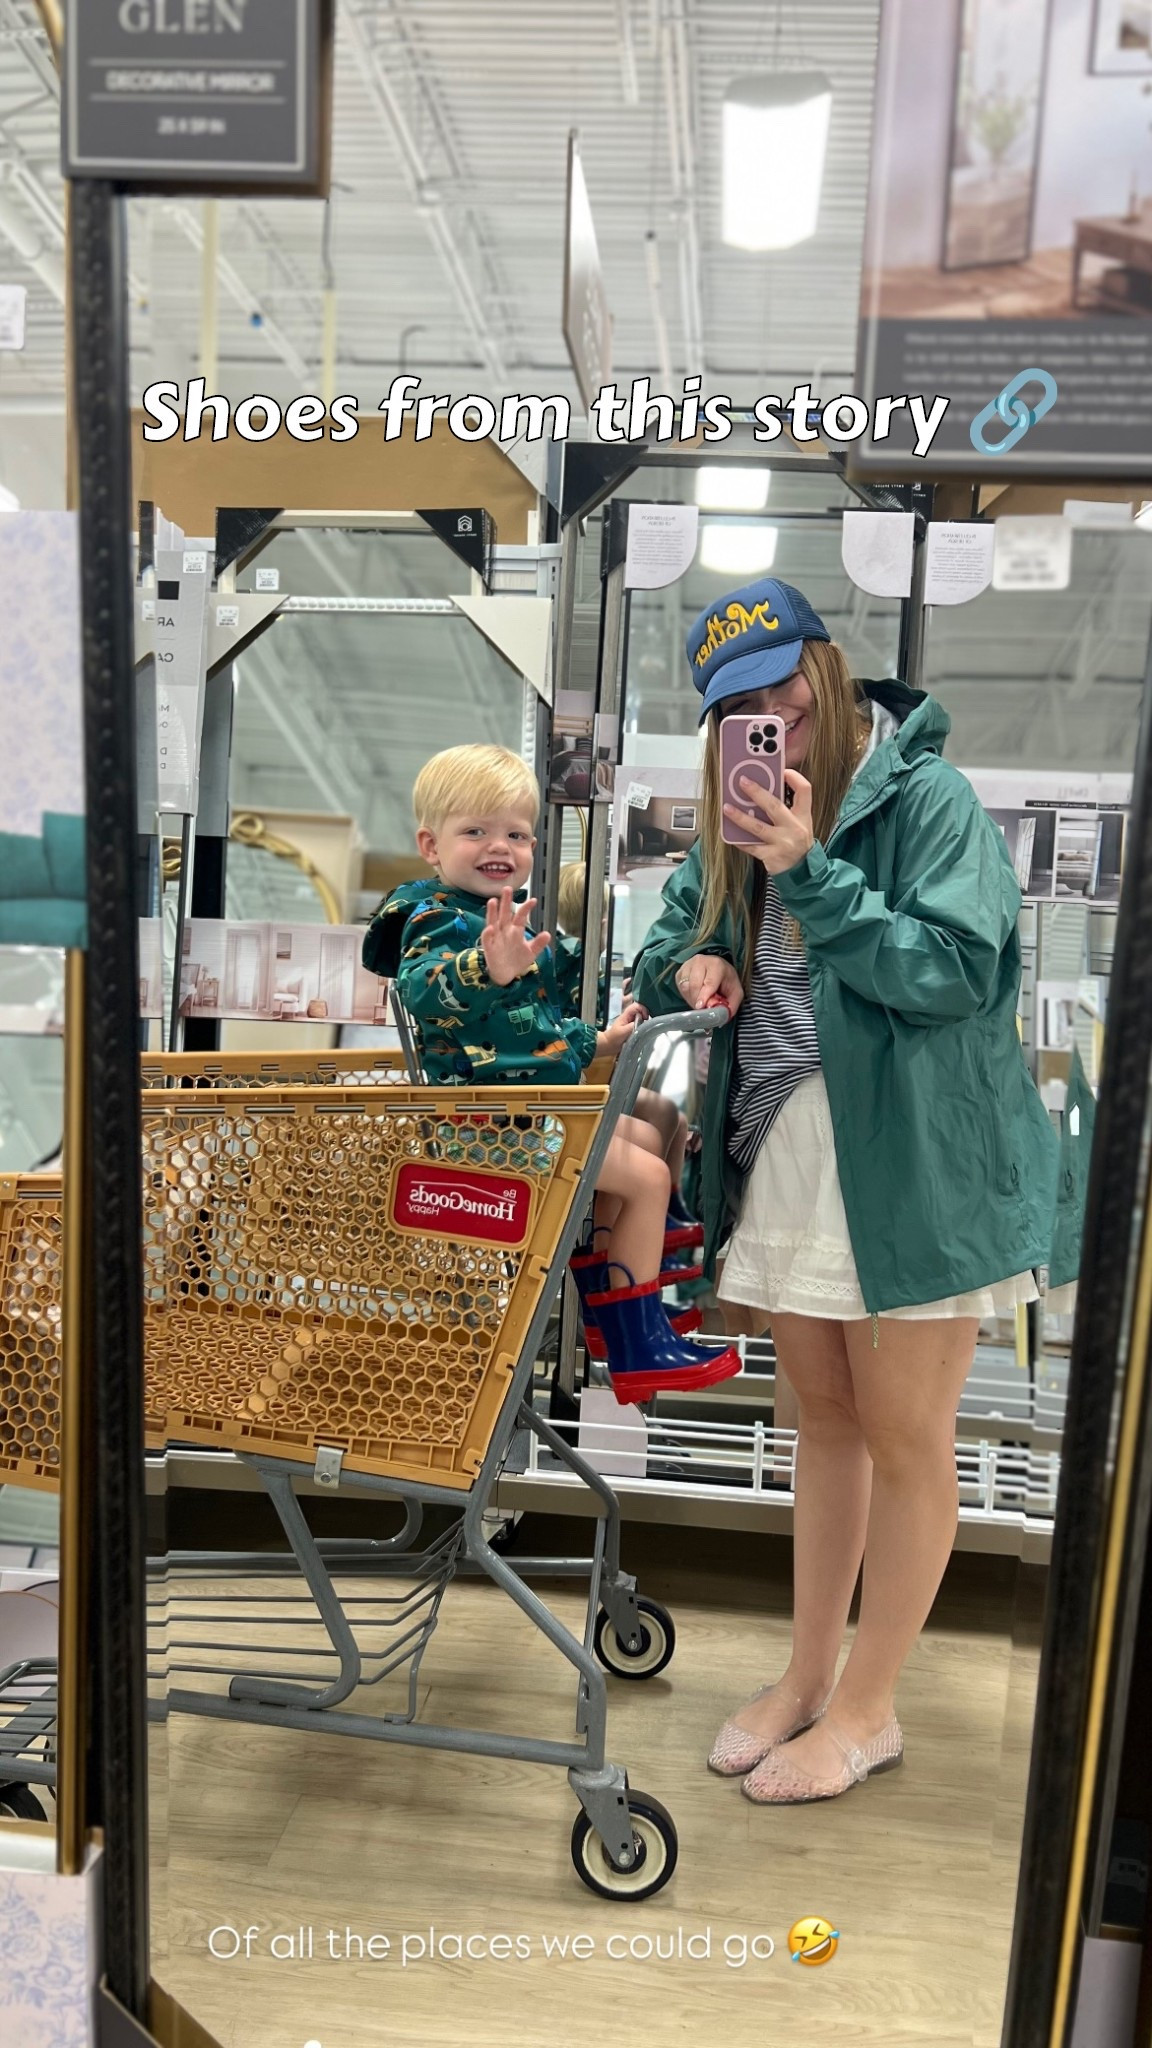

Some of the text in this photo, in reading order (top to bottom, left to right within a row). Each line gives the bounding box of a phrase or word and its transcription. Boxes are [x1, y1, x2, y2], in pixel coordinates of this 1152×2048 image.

[118, 0, 247, 34] GLEN
[105, 70, 275, 92] DECORATIVE MIRROR
